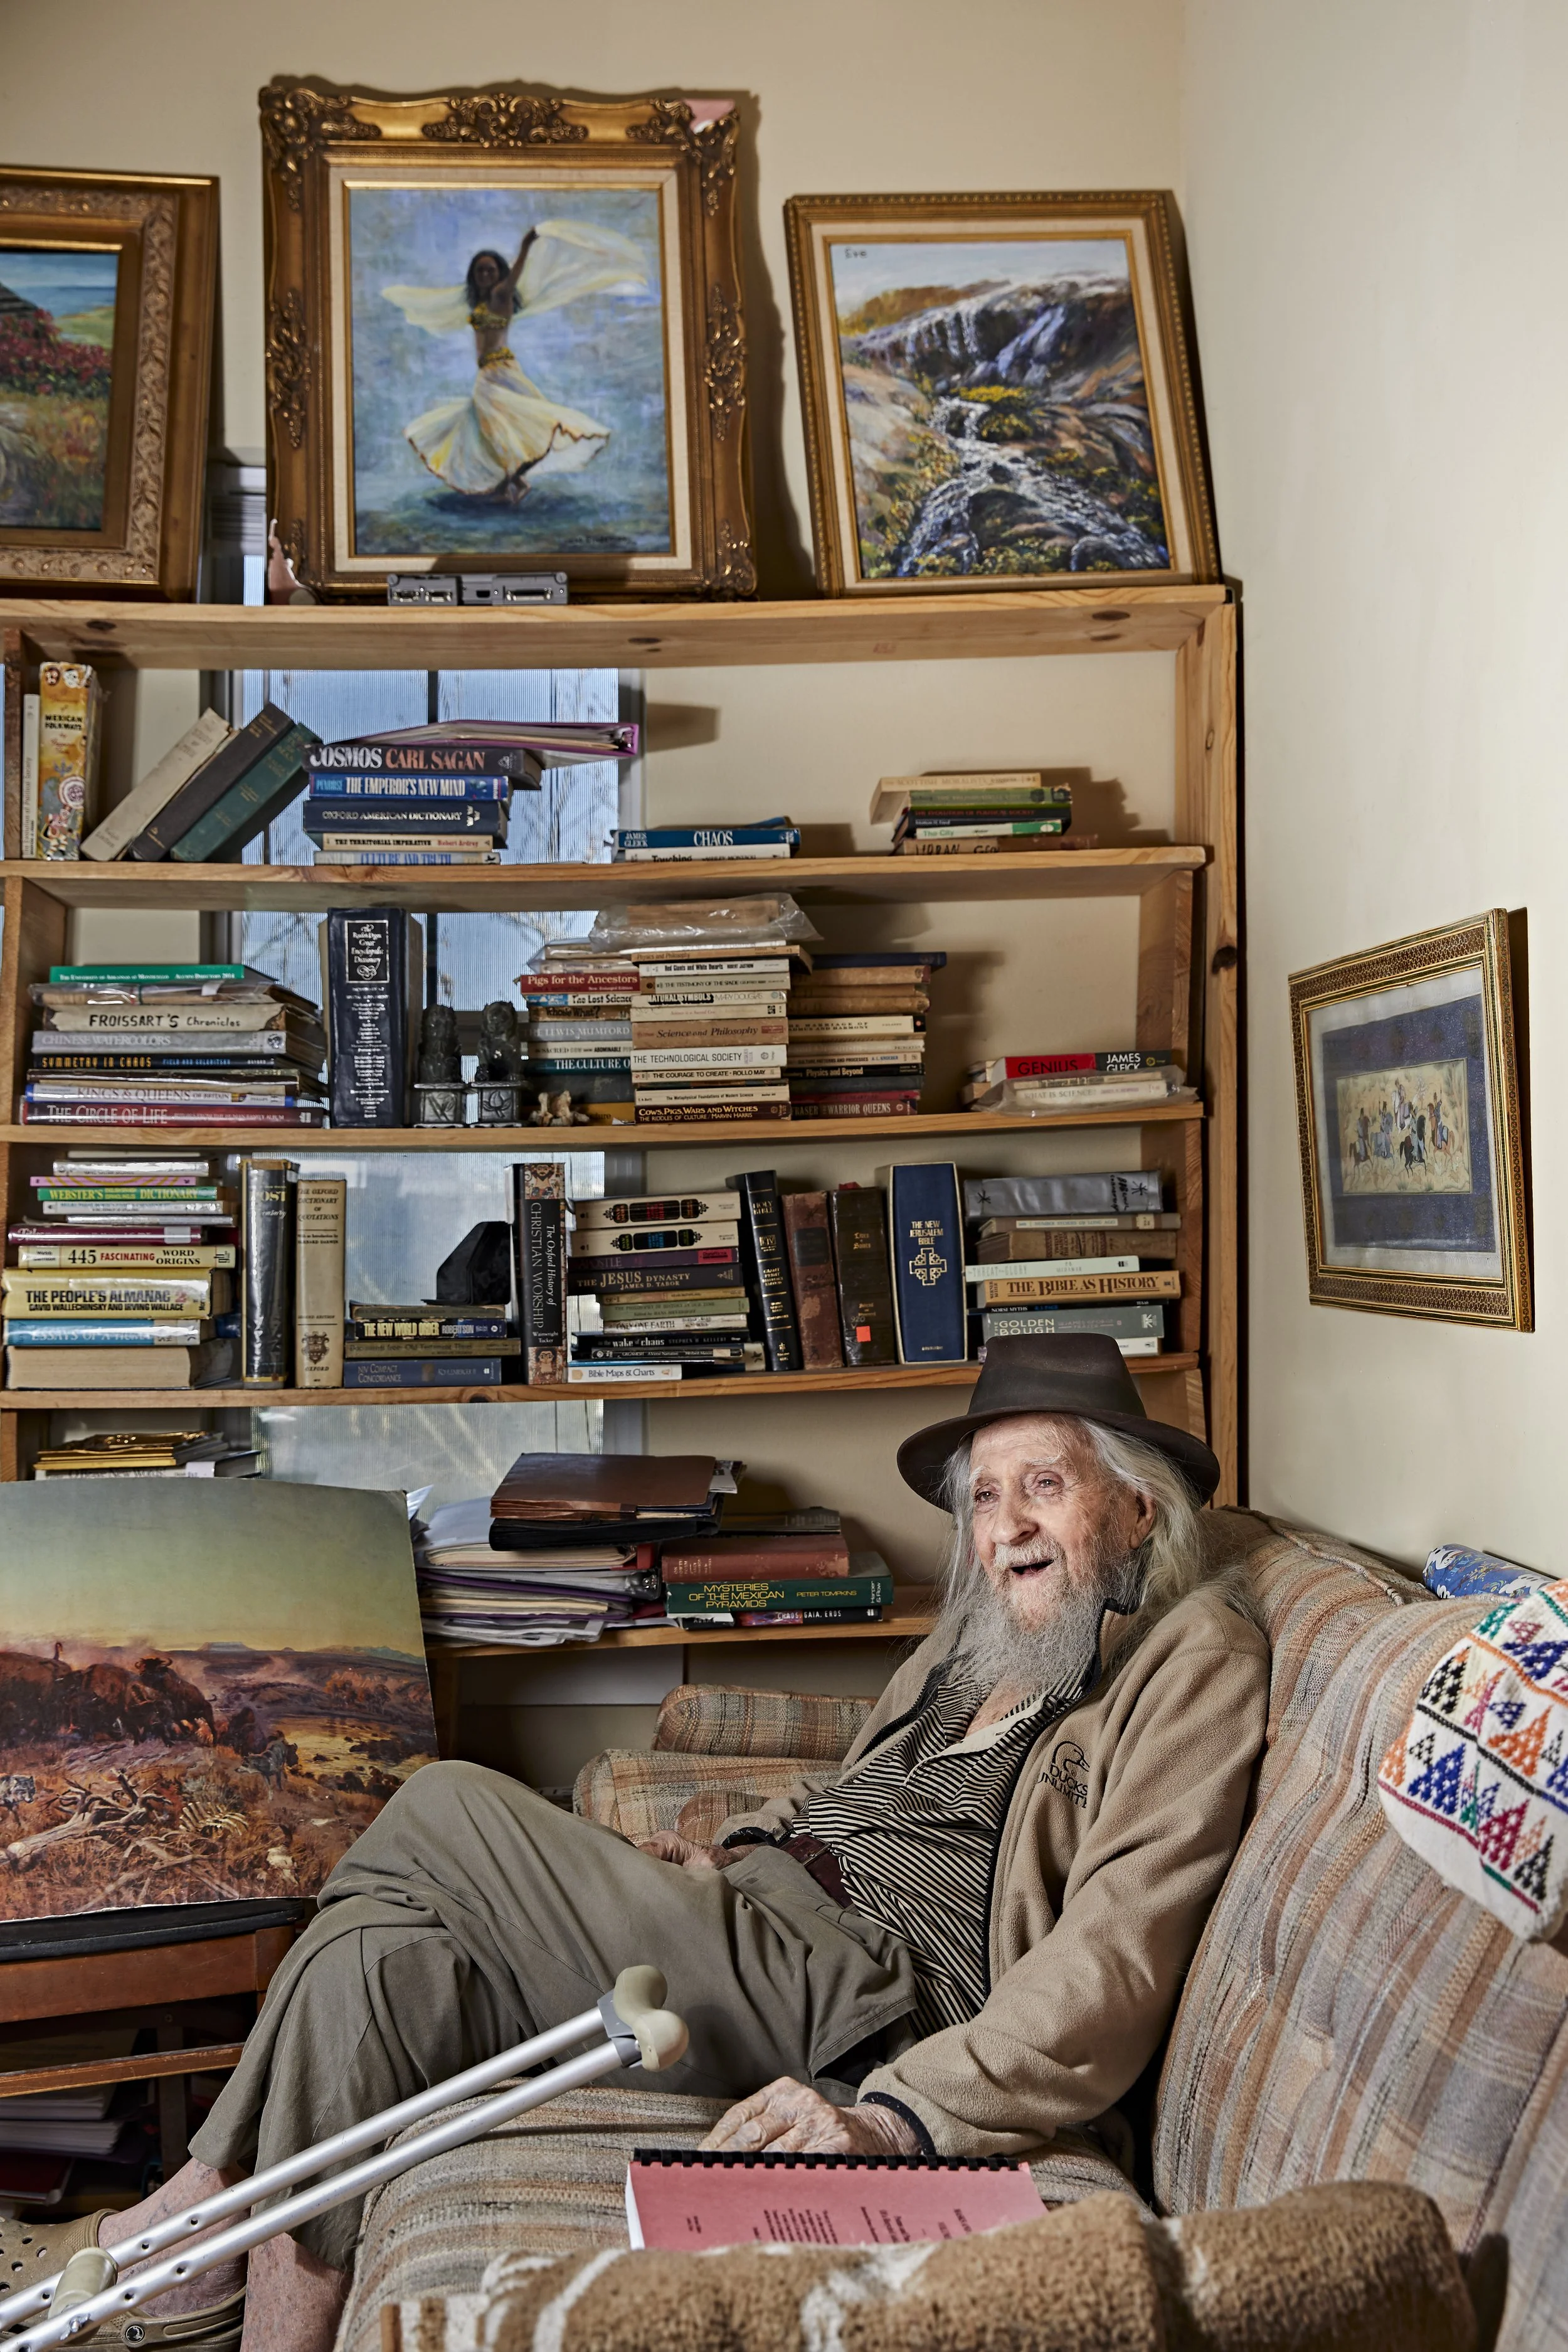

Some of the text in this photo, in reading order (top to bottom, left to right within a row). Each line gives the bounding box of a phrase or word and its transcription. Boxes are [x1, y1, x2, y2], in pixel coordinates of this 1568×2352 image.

[310, 746, 485, 770] COSMOS CARL SAGAN
[346, 777, 466, 797] THE EMPEROR'S NEW MIND
[322, 811, 463, 821] OXFORD AMERICAN DICTIONARY
[694, 831, 734, 846] CHAOS
[527, 975, 638, 987] Pigs for the Ancestors
[588, 994, 632, 1004] Lost Science
[648, 994, 679, 1005] NATURAL
[679, 992, 714, 1004] SYMBOLS
[734, 992, 763, 1000] DOUGLAS
[89, 1013, 241, 1028] FROISSART'S Chronicles
[545, 1028, 575, 1036] LEWIS
[577, 1026, 630, 1035] MUMFORD
[657, 1029, 691, 1038] Science
[711, 1026, 758, 1036] Philosophy
[41, 1035, 171, 1046] CHINESE WATERCOLORS
[42, 1056, 152, 1068] SYMMETRY IN CHAOS
[633, 1053, 742, 1063] THE TECHNOLOGICAL SOCIETY
[1106, 1053, 1141, 1063] JAMES
[554, 1058, 621, 1070] THE CULTURE
[1017, 1060, 1078, 1075] GENIUS
[806, 1068, 829, 1078] Physics
[830, 1068, 840, 1076] and
[842, 1067, 864, 1077] Beyond
[77, 1087, 191, 1103] KINGS QUEENS
[47, 1104, 168, 1124] THE CIRCLE OF LIFE
[827, 1103, 891, 1115] WARRIOR QUEENS
[50, 1189, 104, 1200] WEBSTER'S
[140, 1188, 198, 1200] DICTIONARY
[753, 1201, 773, 1209] HOLY
[911, 1220, 941, 1230] THE NEW
[909, 1228, 943, 1238] JERUSALEM
[918, 1237, 936, 1245] BIBLE
[68, 1249, 97, 1264] 445
[100, 1252, 156, 1261] FASCINATING
[531, 1202, 544, 1329] CHRISTIAN WORSHIP
[546, 1224, 558, 1306] The Oxford History of
[600, 1271, 642, 1287] JESUS
[646, 1273, 691, 1282] DYNASTY
[620, 1282, 645, 1290] JAMES
[1007, 1276, 1159, 1296] THE BIBLE AS HISTORY
[26, 1290, 48, 1303] THE
[51, 1290, 107, 1303] PEOPLE'S
[110, 1290, 171, 1303] ALMANAC
[175, 1290, 188, 1303] 2
[52, 1303, 107, 1311] WALLECHINSKY
[107, 1303, 123, 1311] AND
[124, 1303, 151, 1311] IRVING
[151, 1303, 184, 1311] WALLACE
[364, 1321, 474, 1337] THE NEW WORLD ORDER ROBERTSON
[650, 1320, 675, 1329] EARTH
[999, 1319, 1055, 1328] GOLDEN
[1000, 1326, 1055, 1336] BOUGH
[612, 1337, 665, 1348] wake chaos
[369, 1364, 398, 1374] COMPACT
[588, 1368, 655, 1379] Bible Maps Charts
[358, 1373, 401, 1383] CONCORDANCE
[704, 1583, 769, 1594] MYSTERIES
[689, 1590, 785, 1602] OF THE MEXICAN
[706, 1599, 767, 1609] PYRAMIDS
[824, 1610, 842, 1618] EROS
[1049, 1764, 1088, 1796] DUCKS
